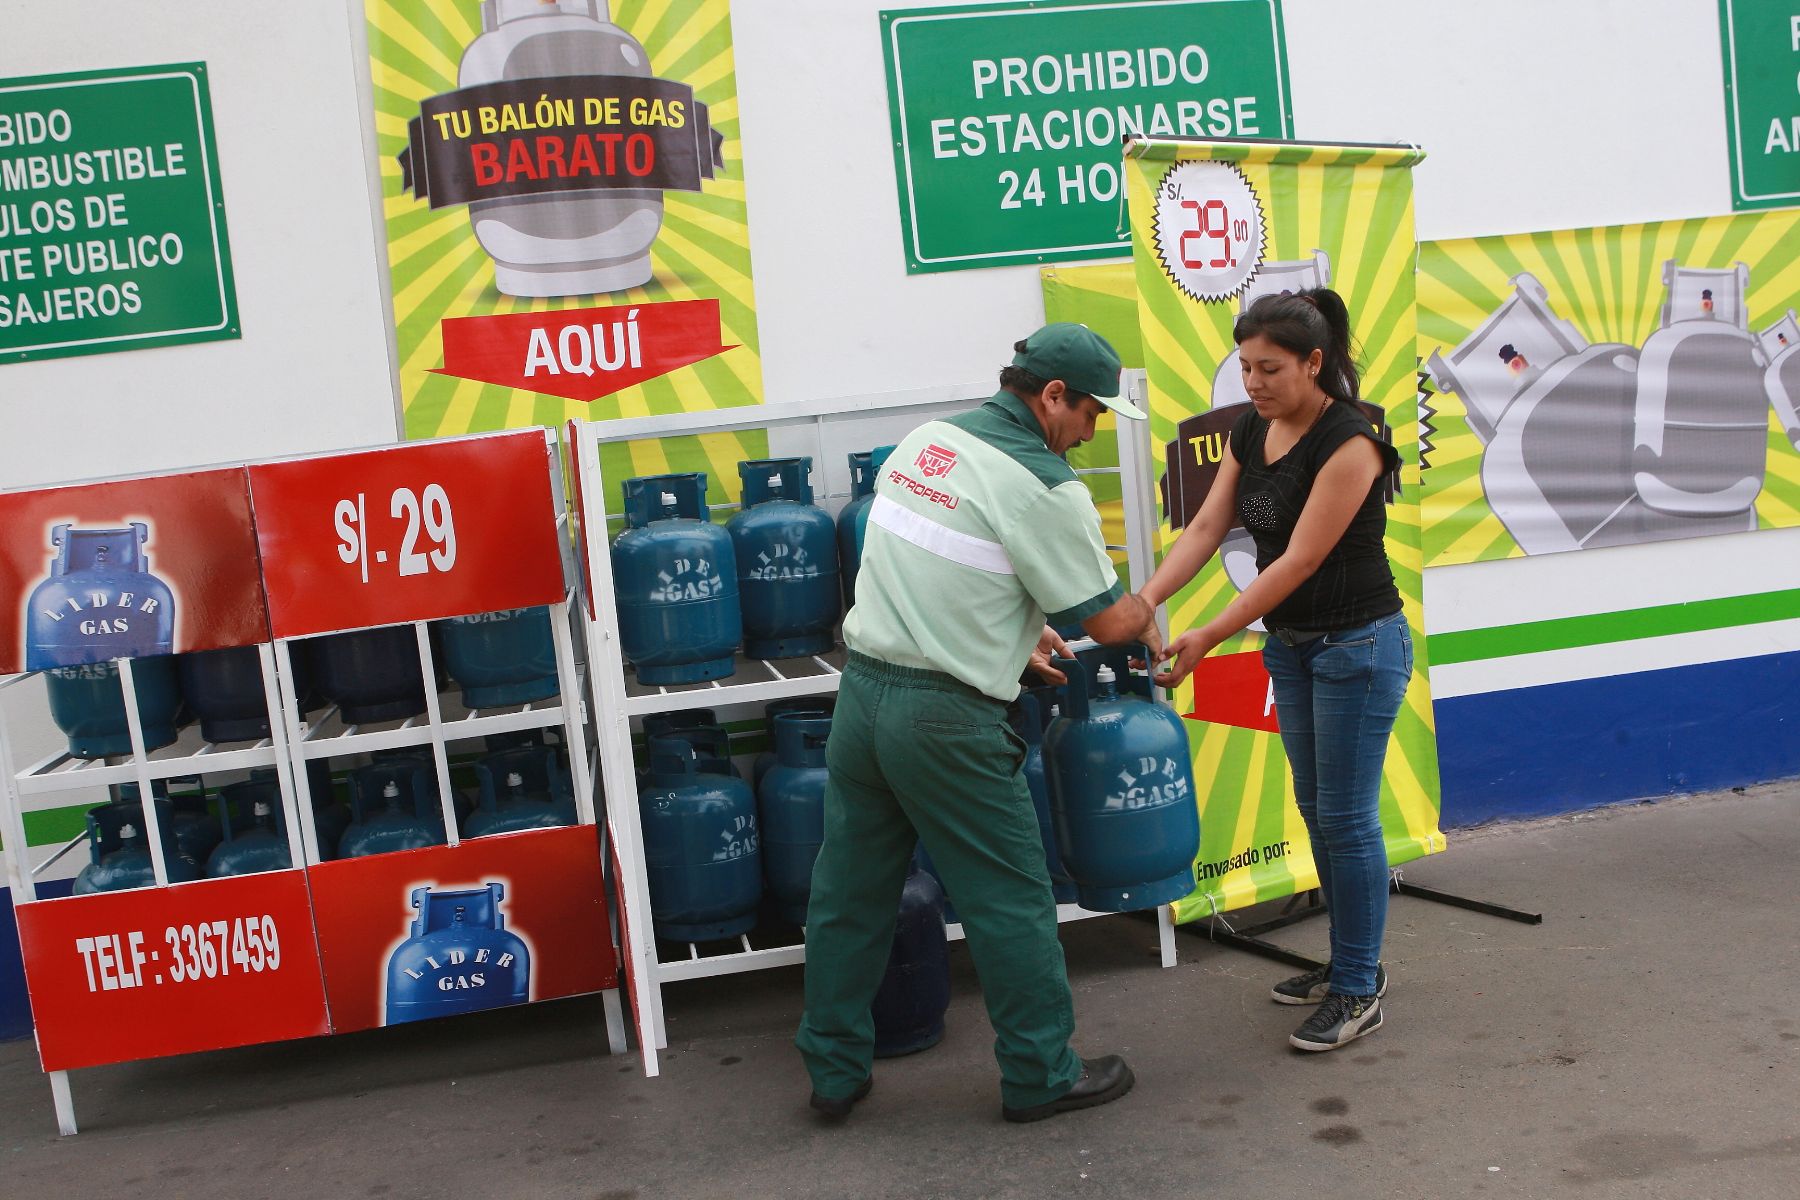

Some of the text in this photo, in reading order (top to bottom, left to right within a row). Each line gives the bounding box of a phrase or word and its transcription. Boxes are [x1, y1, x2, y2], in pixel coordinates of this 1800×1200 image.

[972, 44, 1209, 99] PROHIBIDO
[433, 94, 686, 140] TU BALÓN DE GAS
[931, 96, 1260, 159] ESTACIONARSE
[0, 143, 187, 193] MBUSTIBLE
[470, 133, 655, 187] BARATO
[998, 161, 1128, 210] 24 HO
[84, 193, 129, 229] DE
[42, 232, 184, 278] PUBLICO
[0, 281, 142, 329] SAJEROS
[523, 309, 642, 378] AQUÍ
[1188, 432, 1222, 466] TU
[888, 470, 960, 510] PETROPERU
[44, 592, 158, 622] LIDER
[80, 617, 129, 635] GAS
[1196, 840, 1291, 882] Envasado por:
[165, 914, 281, 983] 3367459
[402, 949, 515, 981] LIDER
[438, 972, 486, 992] GAS
